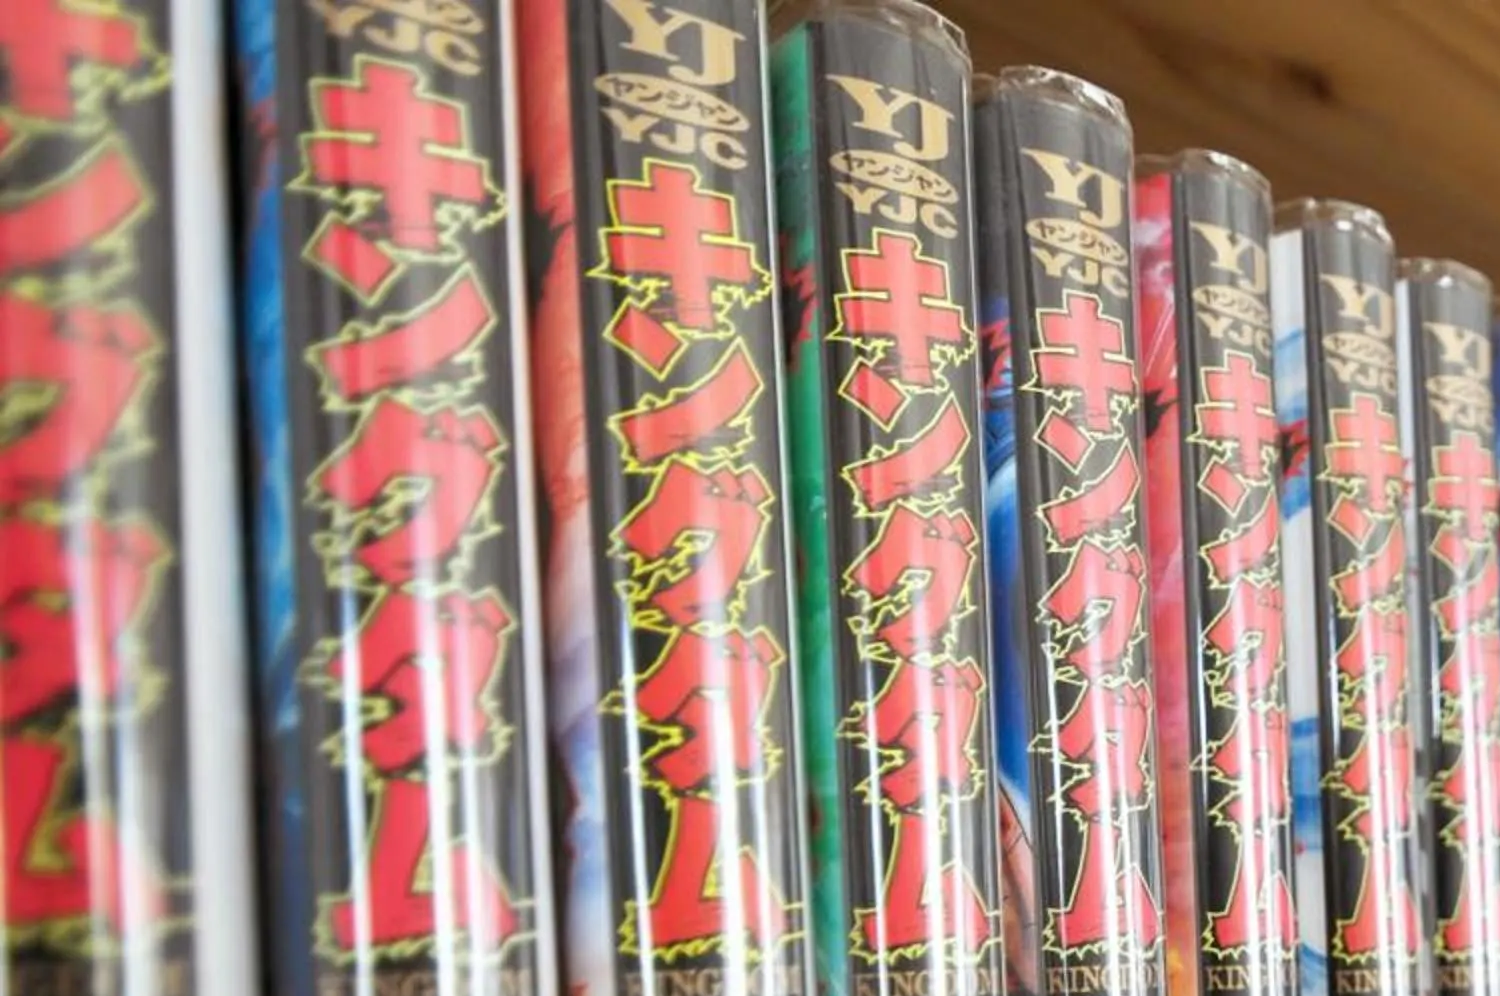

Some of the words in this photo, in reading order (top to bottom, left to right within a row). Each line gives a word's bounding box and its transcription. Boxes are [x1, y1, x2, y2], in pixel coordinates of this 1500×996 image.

[604, 0, 747, 85] YJ
[604, 107, 749, 170] YJC
[826, 75, 955, 161] YJ
[835, 181, 958, 239] YJC
[1020, 148, 1124, 229] YJ
[1030, 246, 1128, 298] YJC
[1190, 221, 1268, 294] YJ
[1196, 311, 1269, 354] YJC
[1320, 272, 1395, 340] YJ
[1422, 321, 1492, 380] YJ
[288, 54, 537, 963] キングダム
[587, 157, 803, 962] キングダム
[826, 228, 1001, 963] キングダム
[1021, 292, 1165, 963] キングダム
[1186, 350, 1300, 960] キングダム
[1318, 391, 1424, 963] キングダム
